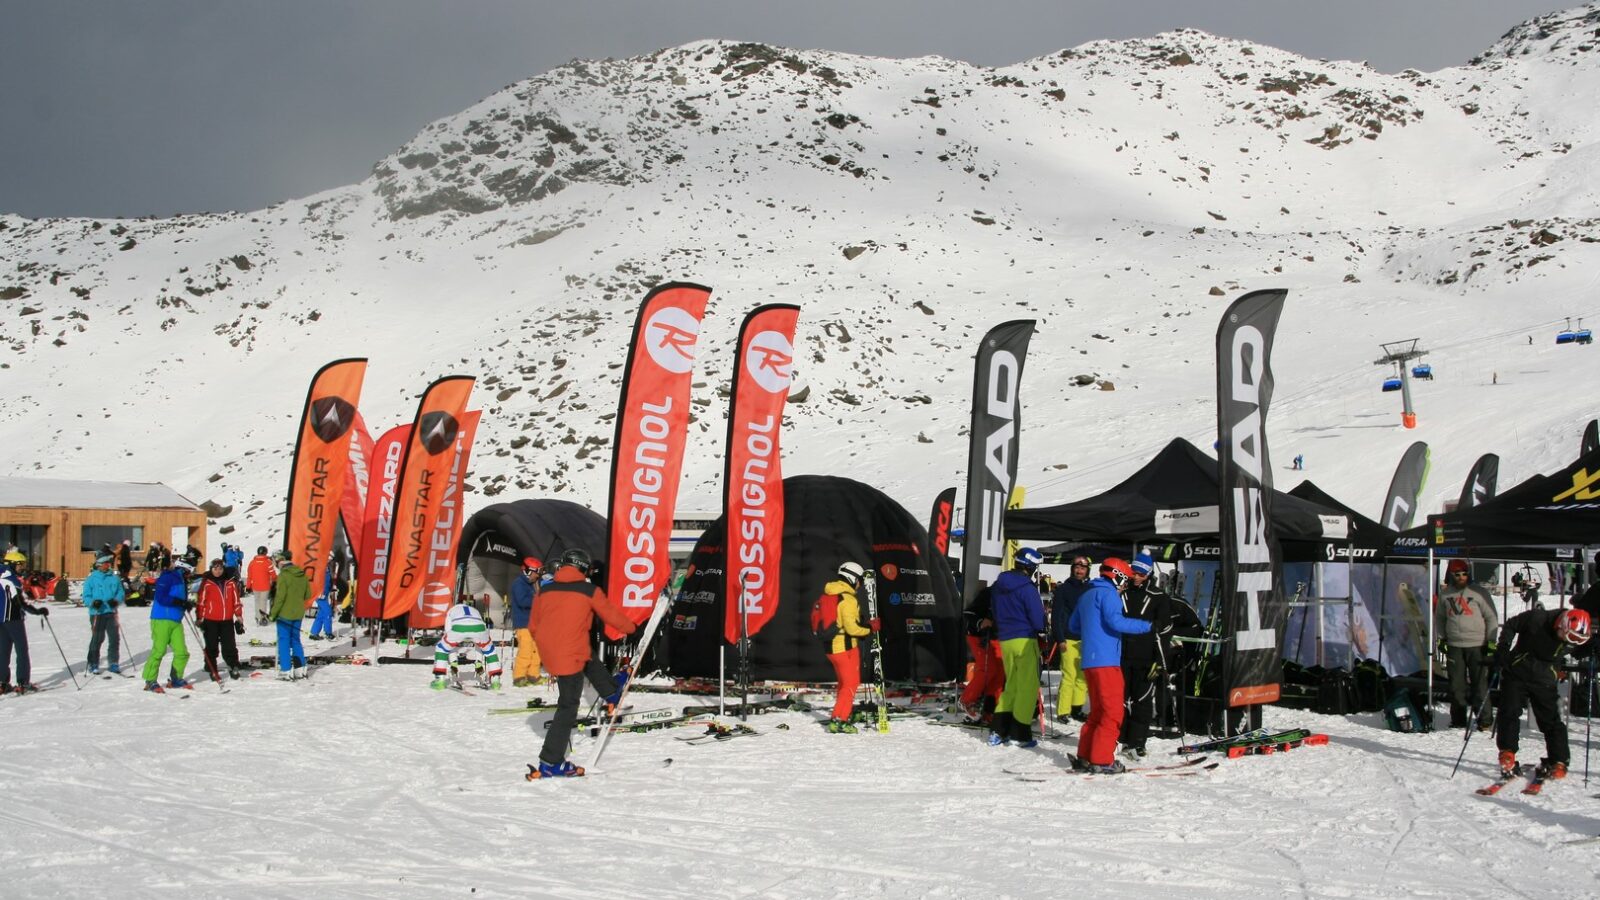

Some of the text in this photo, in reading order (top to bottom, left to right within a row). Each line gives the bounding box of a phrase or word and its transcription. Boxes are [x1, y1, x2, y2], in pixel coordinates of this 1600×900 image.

[303, 457, 331, 583] DYNASTAR
[373, 441, 402, 575] BLIZZARD
[400, 468, 435, 589] DYNASTAR
[493, 543, 517, 557] ATOMIC
[622, 395, 673, 609] ROSSIGNOL
[738, 415, 774, 615] ROSSIGNOL
[1163, 511, 1200, 519] HEAD
[1231, 325, 1276, 651] HEAD
[641, 711, 673, 719] HEAD
